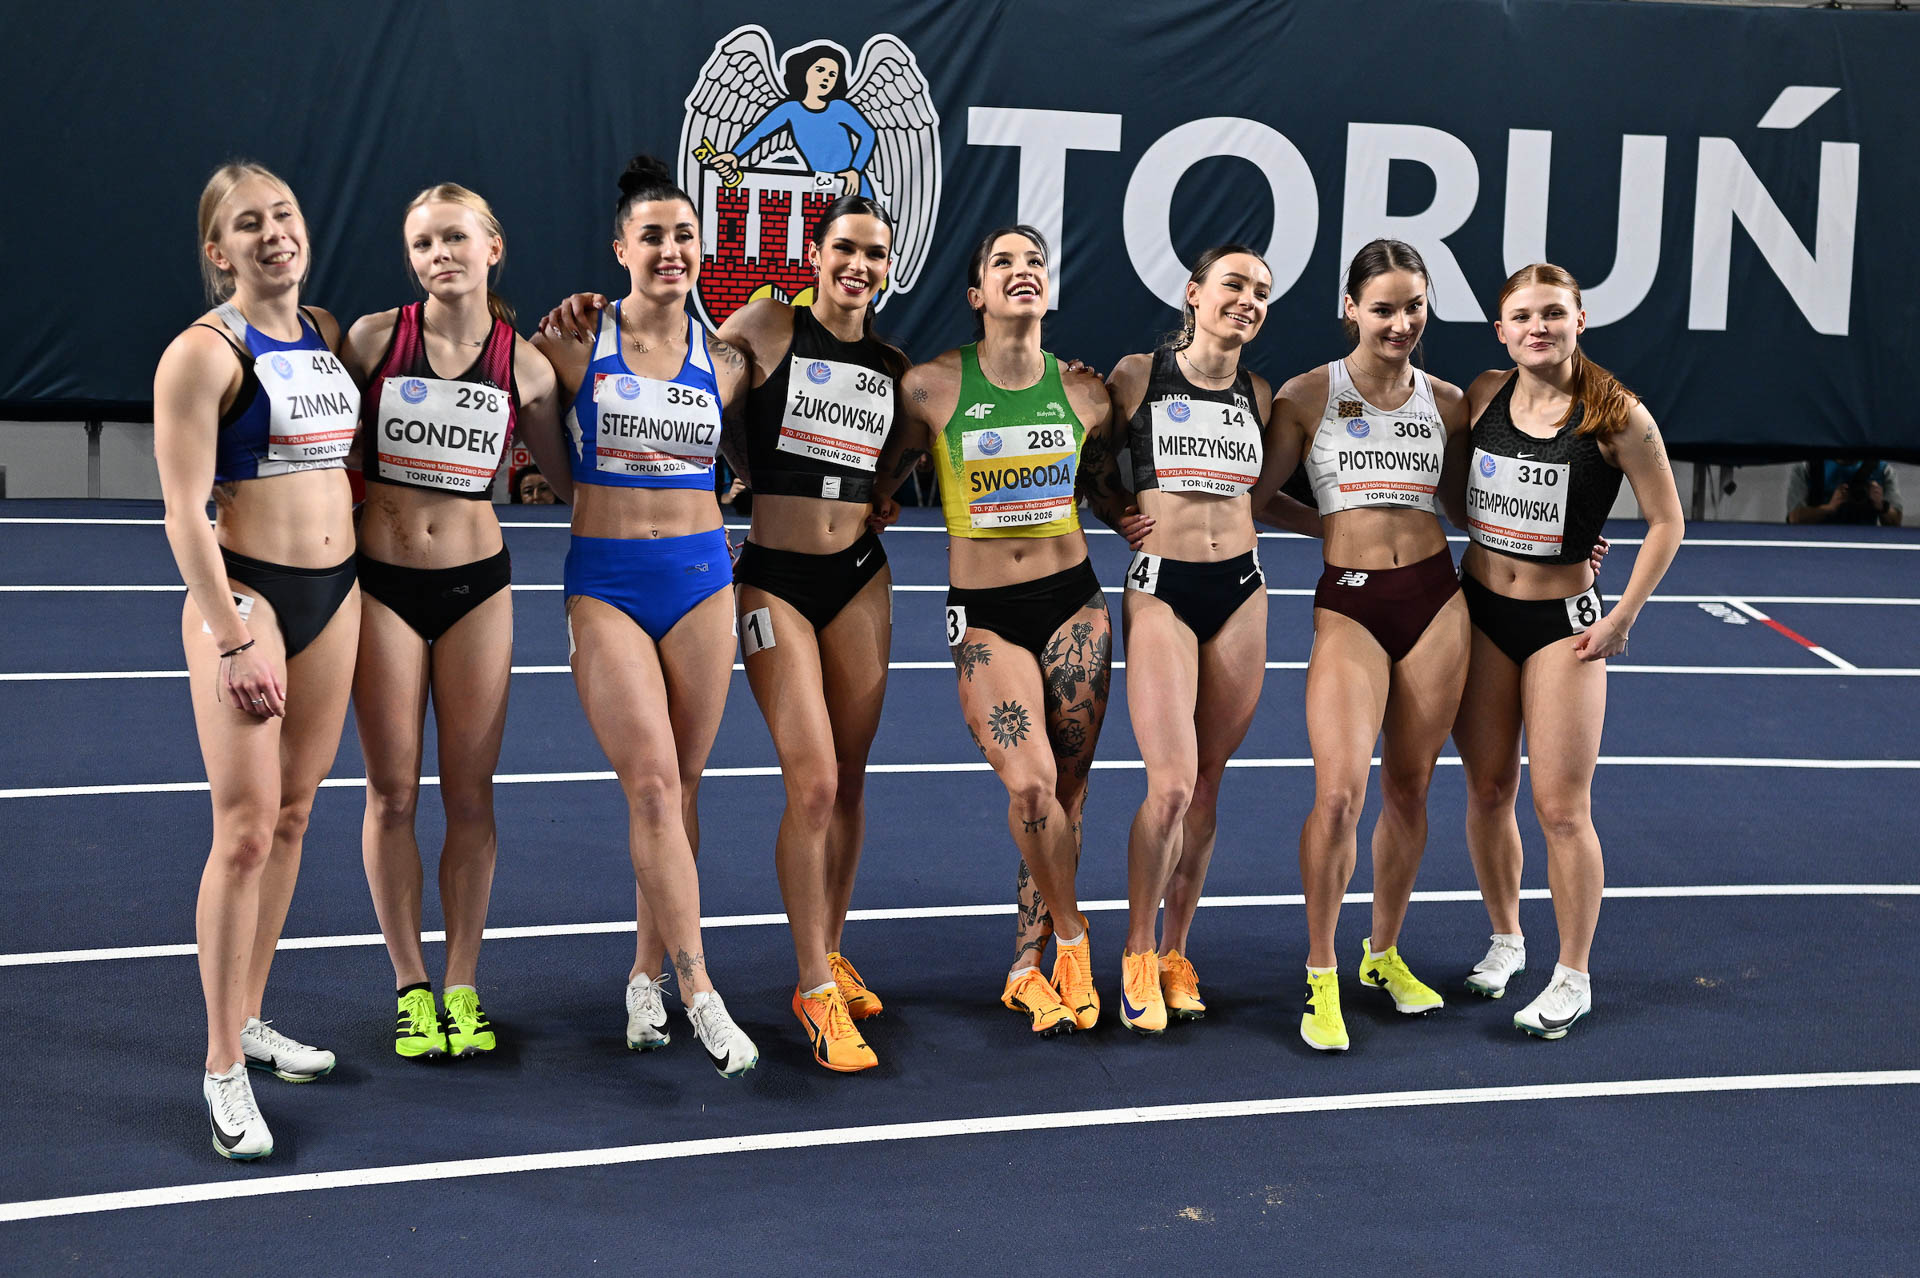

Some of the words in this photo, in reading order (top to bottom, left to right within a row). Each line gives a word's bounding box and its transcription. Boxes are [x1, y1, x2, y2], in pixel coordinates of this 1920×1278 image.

[966, 86, 1860, 337] TORUŃ
[312, 356, 342, 374] 414
[855, 372, 887, 398] 366
[287, 392, 353, 420] ZIMNA
[455, 387, 499, 413] 298
[667, 387, 709, 408] 356
[1162, 393, 1191, 401] JAKO
[791, 390, 885, 436] ŻUKOWSKA
[964, 402, 996, 420] 4F
[1221, 408, 1245, 427] 14
[384, 417, 499, 455] GONDEK
[601, 413, 715, 446] STEFANOWICZ
[796, 432, 812, 441] PZLA
[1027, 429, 1066, 450] 288
[1393, 421, 1432, 439] 308
[303, 442, 337, 456] TORUŃ
[806, 445, 840, 460] TORUŃ
[841, 453, 861, 464] 2026
[1158, 435, 1258, 464] MIERZYŃSKA
[624, 461, 661, 472] TORUŃ
[663, 463, 686, 472] 2026
[1338, 450, 1440, 474] PIOTROWSKA
[405, 470, 443, 484] TORUŃ
[446, 477, 471, 487] 2026
[970, 463, 1071, 493] SWOBODA
[1181, 479, 1213, 489] TORUŃ
[1215, 483, 1235, 493] 2026
[1517, 465, 1559, 487] 310
[1365, 491, 1398, 501] TORUŃ
[1399, 493, 1420, 503] 2026
[1468, 486, 1560, 523] STEMPKOWSKA
[997, 511, 1032, 523] TORUŃ
[1034, 510, 1053, 521] 2026
[1481, 533, 1509, 547] TORUŃ
[1510, 541, 1533, 551] 2026
[1504, 529, 1538, 541] Mistrzostwa
[1131, 556, 1150, 588] 4
[1576, 595, 1597, 627] 8
[747, 613, 764, 648] 1
[946, 609, 960, 643] 3
